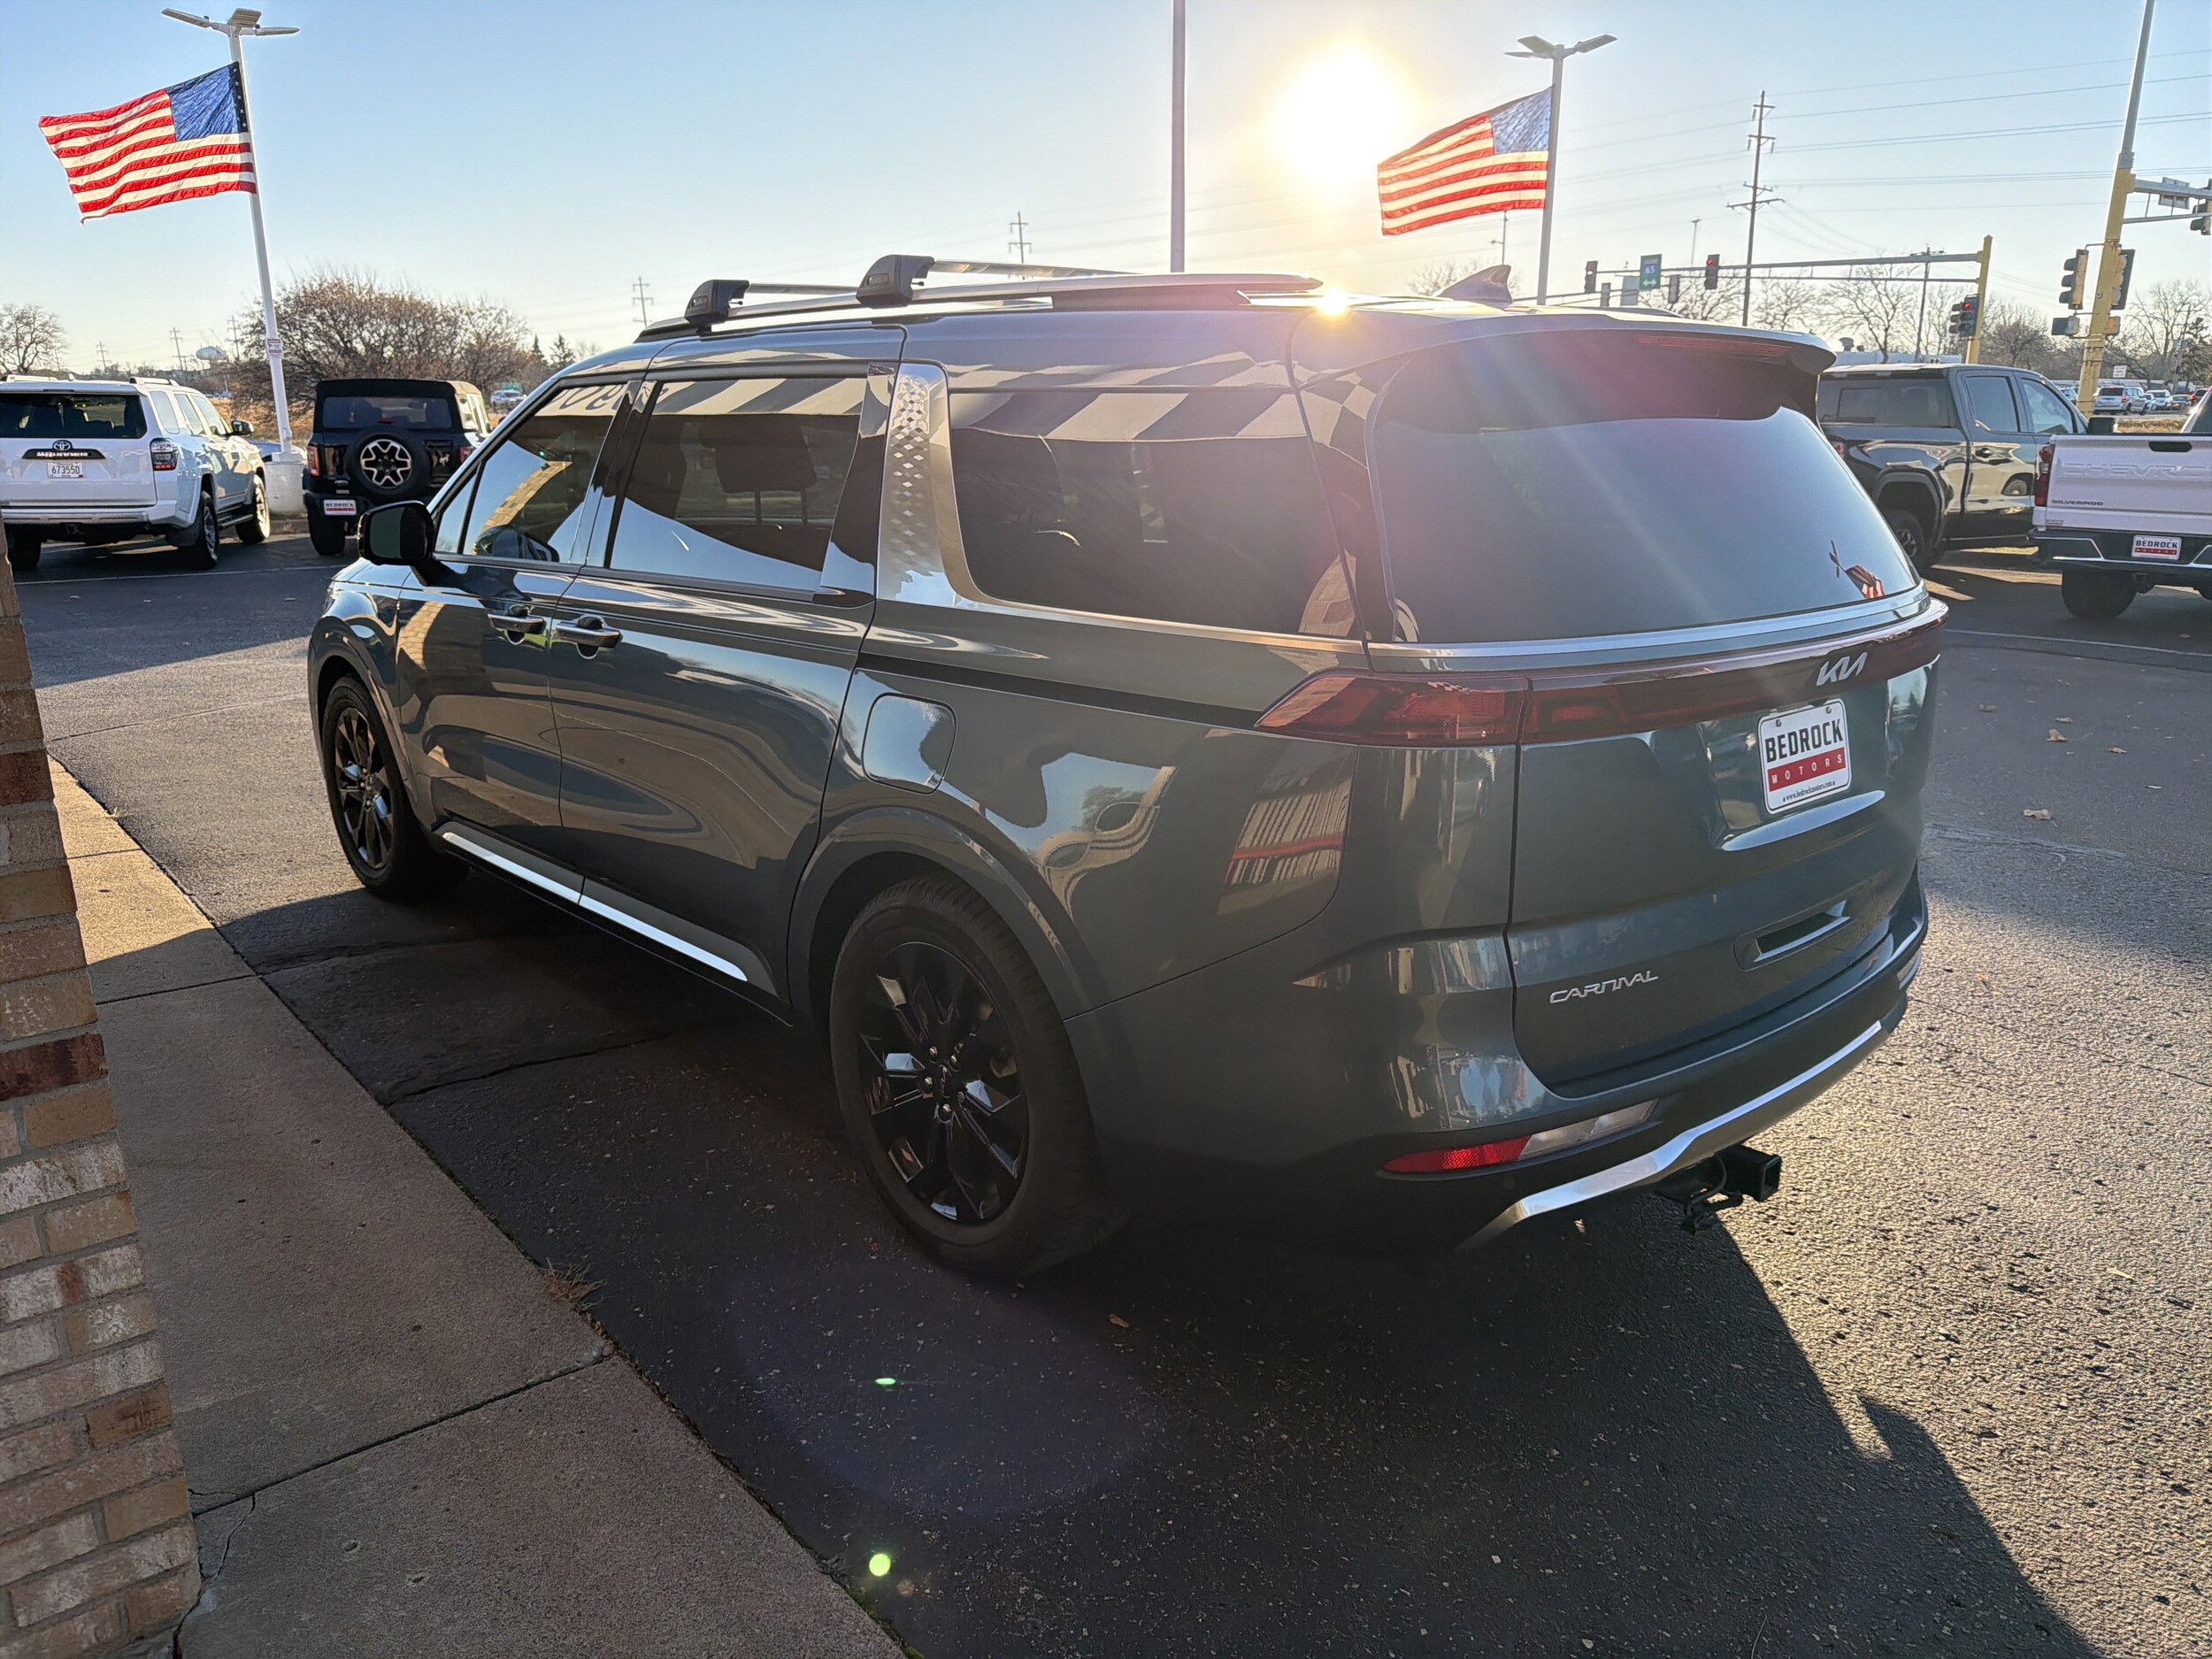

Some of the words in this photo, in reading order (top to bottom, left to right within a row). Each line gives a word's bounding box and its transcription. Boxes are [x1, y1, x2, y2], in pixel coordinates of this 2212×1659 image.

[2135, 540, 2177, 549] BEDROCK
[1816, 652, 1868, 686] KIA
[1765, 718, 1843, 763] BEDROCK
[1771, 754, 1843, 784] MOTORS
[1549, 971, 1659, 1003] CARNIVAL
